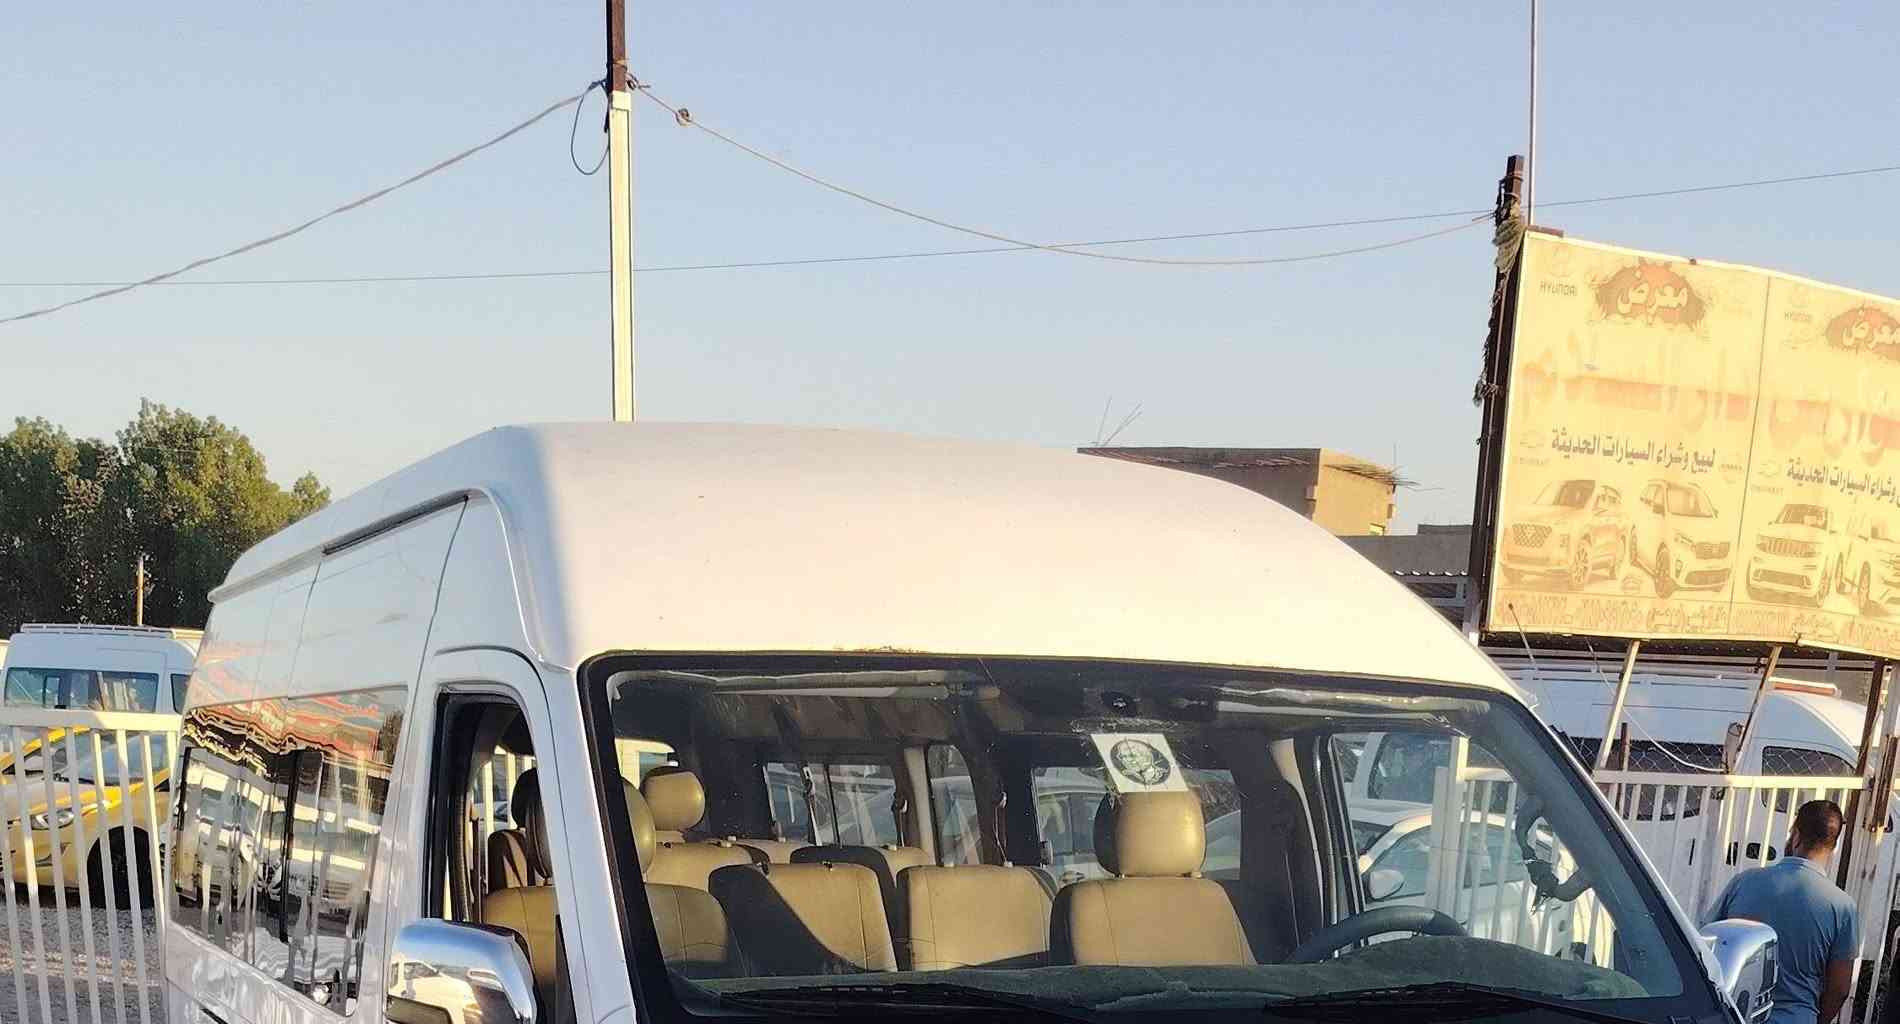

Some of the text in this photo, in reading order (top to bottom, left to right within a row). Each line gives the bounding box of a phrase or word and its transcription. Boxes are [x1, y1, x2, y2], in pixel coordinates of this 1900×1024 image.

[1551, 426, 1716, 474] لبيع وشراء السيارات الحديثة
